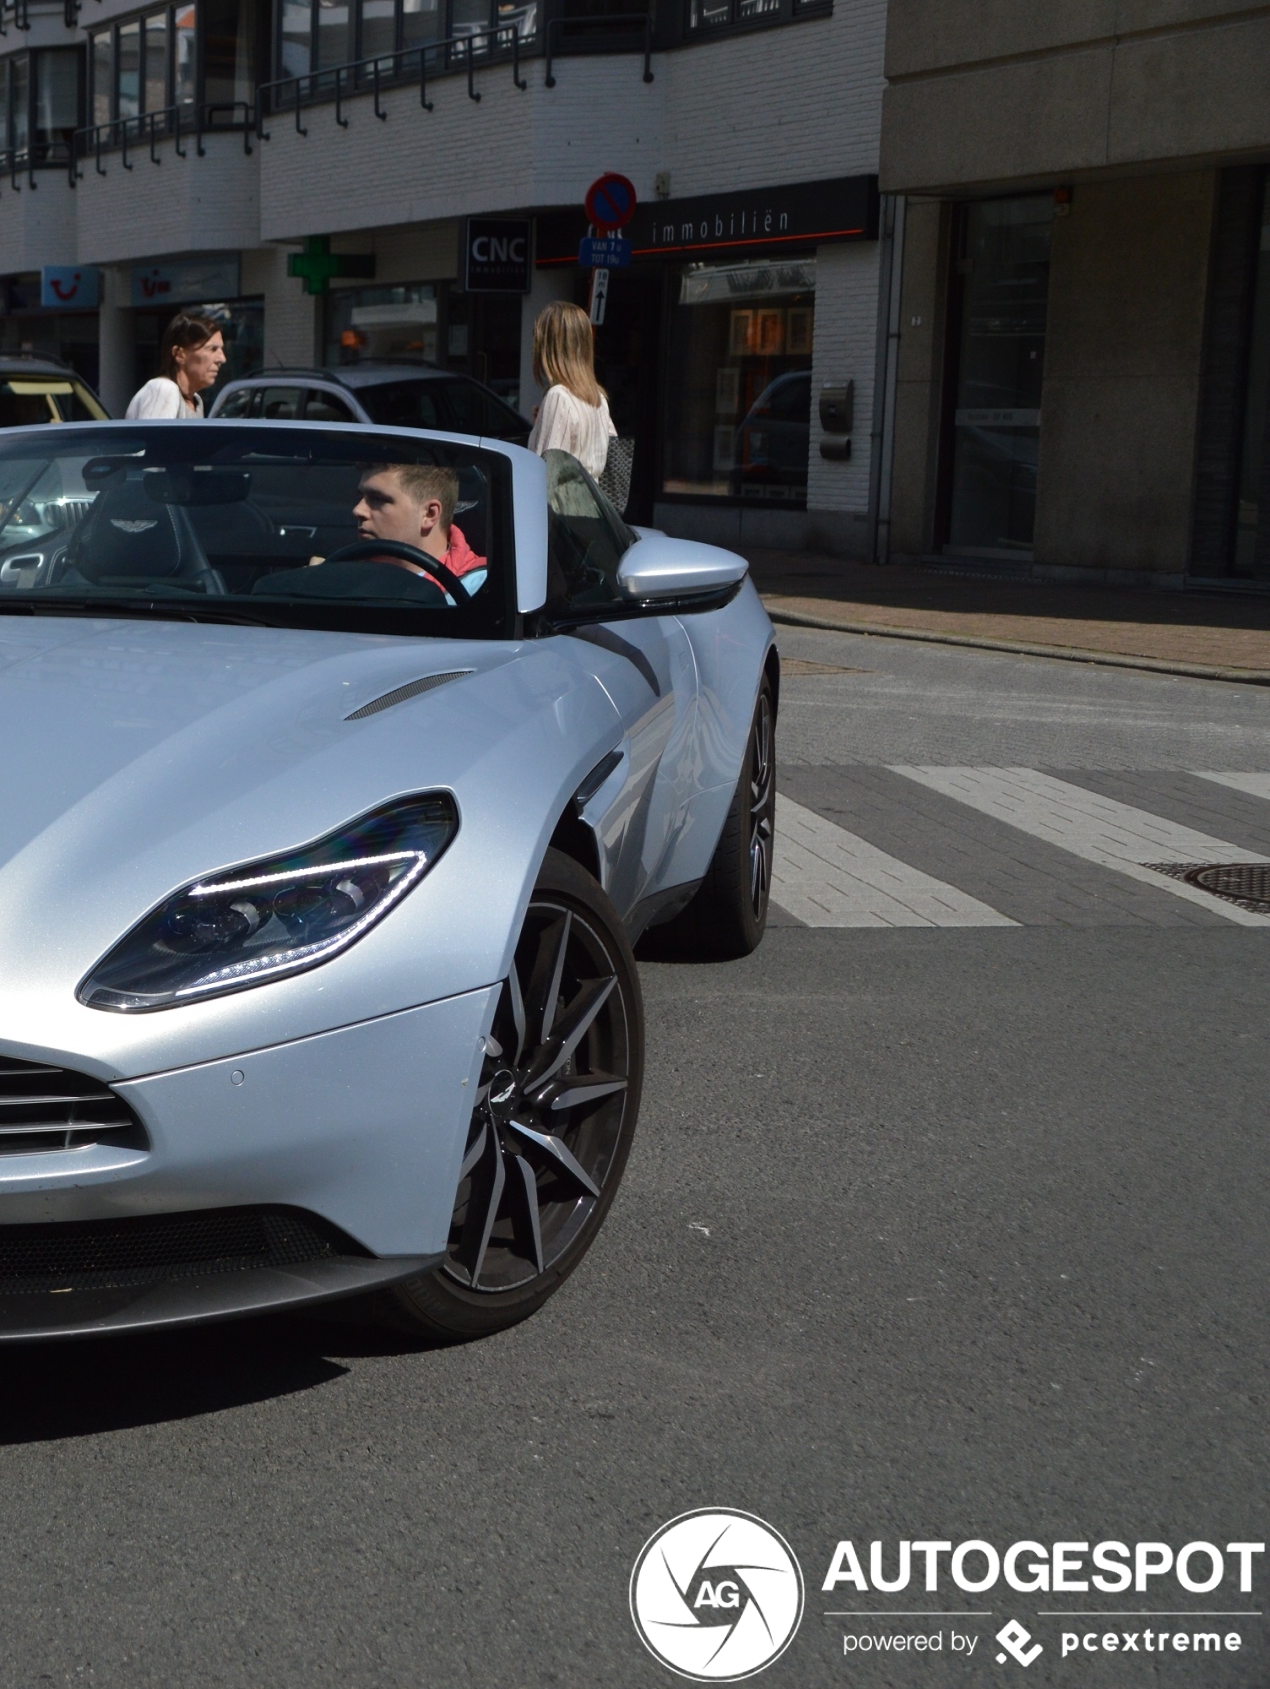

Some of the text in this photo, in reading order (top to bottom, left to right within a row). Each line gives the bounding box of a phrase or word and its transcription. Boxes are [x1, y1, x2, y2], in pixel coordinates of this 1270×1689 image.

[652, 208, 788, 244] immobiliën
[471, 235, 526, 263] CNC
[592, 241, 607, 251] VAN
[610, 241, 615, 251] 7
[591, 254, 605, 264] TOT
